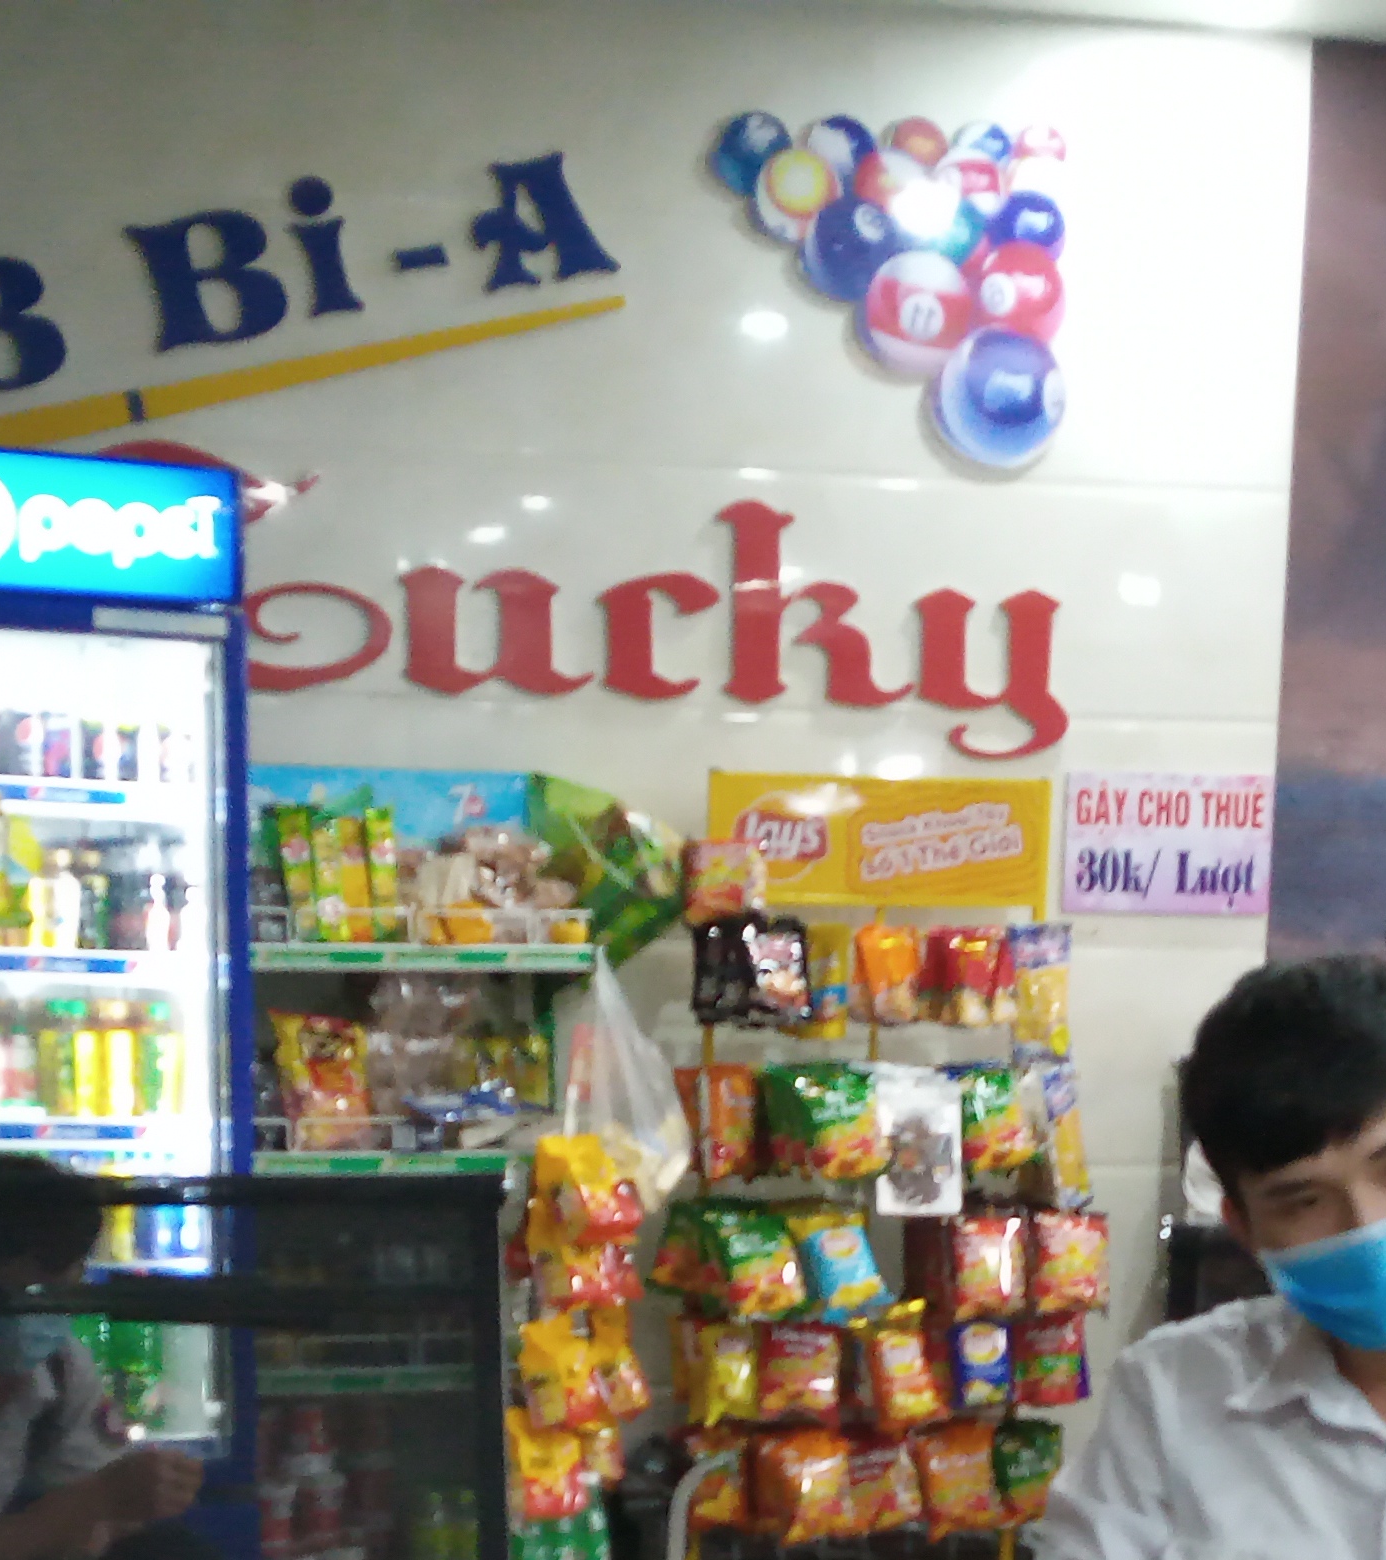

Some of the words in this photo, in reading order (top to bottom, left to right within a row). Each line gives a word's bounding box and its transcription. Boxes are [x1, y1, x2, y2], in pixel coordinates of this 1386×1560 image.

[17, 493, 221, 570] pepsi
[1137, 788, 1191, 827] CHO
[1201, 783, 1265, 829] THUÊ
